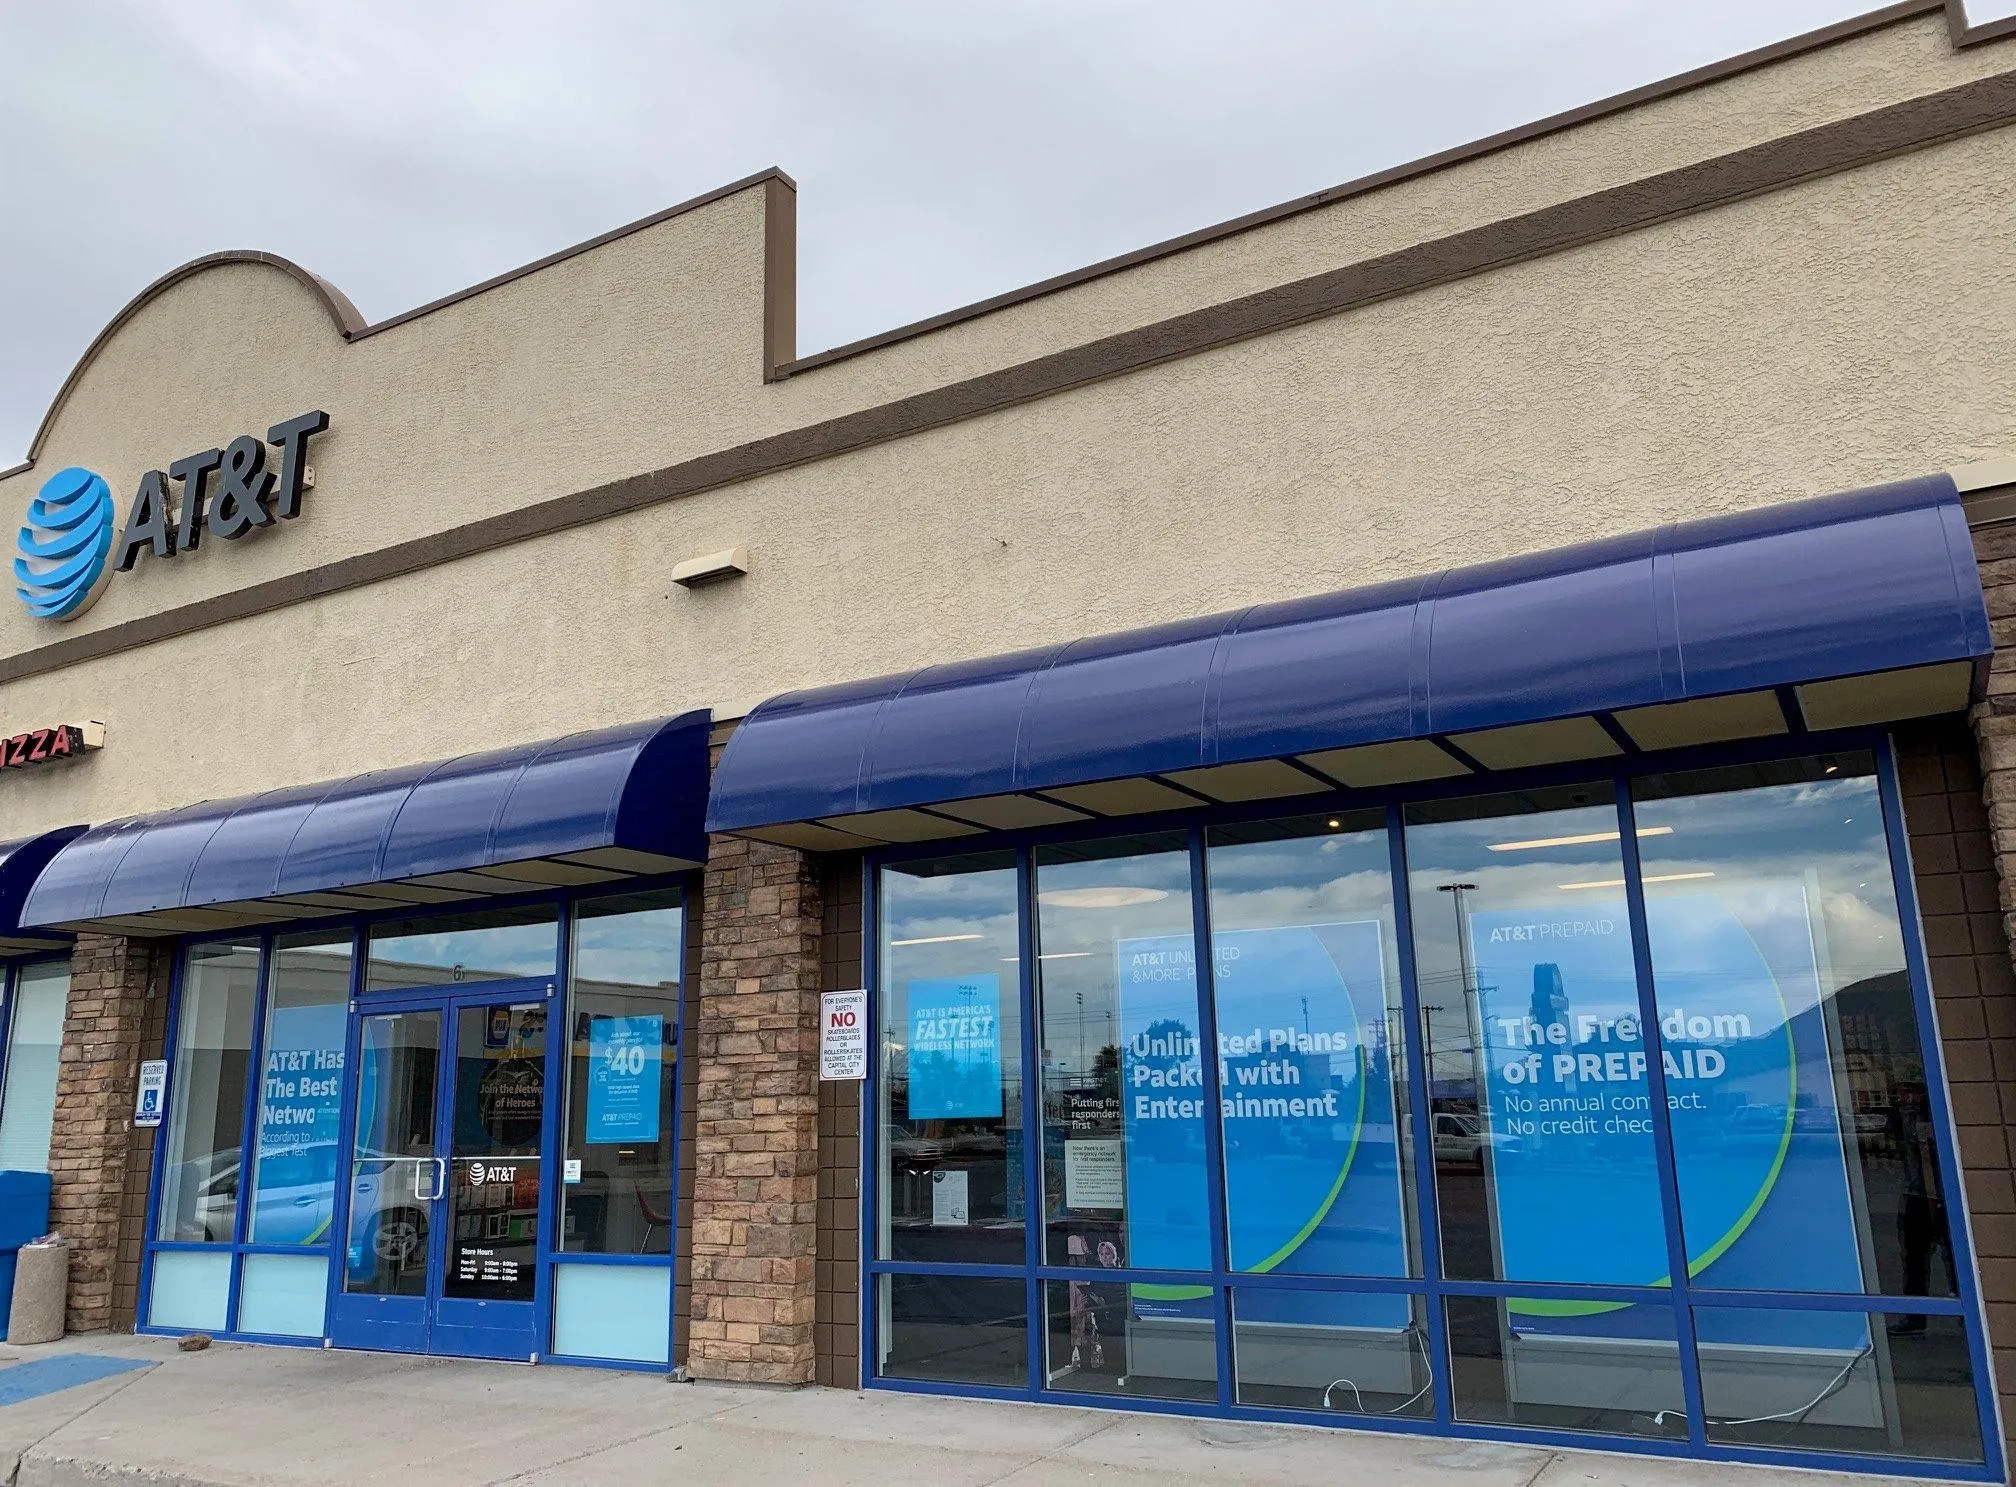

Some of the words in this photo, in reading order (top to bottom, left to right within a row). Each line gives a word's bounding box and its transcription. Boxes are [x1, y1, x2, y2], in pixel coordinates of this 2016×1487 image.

[114, 410, 328, 571] AT&T
[0, 725, 71, 768] IZZA
[1490, 925, 1535, 942] AT&T
[1539, 920, 1614, 938] PREPAID
[1132, 952, 1166, 966] AT&T
[1169, 947, 1240, 964] UNLTED
[1187, 965, 1231, 979] PNS
[831, 1012, 856, 1027] NO
[916, 1008, 936, 1019] AT&T
[938, 1008, 946, 1017] IS
[947, 1004, 992, 1017] AMERICA'S
[915, 1016, 993, 1040] FASTEST
[1497, 1016, 1567, 1046] The
[1578, 1009, 1750, 1044] Fredom
[913, 1040, 952, 1051] WIRELESS
[954, 1038, 995, 1049] NETWORK
[1133, 1028, 1262, 1057] Unlimted
[1270, 1027, 1348, 1053] Plans
[268, 1051, 310, 1072] AT&T
[314, 1049, 345, 1070] Has
[604, 1045, 645, 1076] $40
[1502, 1054, 1541, 1084] of
[1552, 1049, 1726, 1083] PREPAID
[1235, 1059, 1300, 1086] with
[266, 1077, 295, 1098] The
[300, 1076, 338, 1097] Best
[480, 1083, 498, 1094] Join
[499, 1083, 514, 1094] the
[514, 1083, 543, 1094] Netwo
[496, 1098, 505, 1108] of
[506, 1098, 536, 1108] Heroes
[1071, 1098, 1104, 1109] Putting
[1105, 1097, 1120, 1107] firs
[1135, 1092, 1338, 1119] Enterainment
[1505, 1096, 1533, 1113] No
[1539, 1093, 1605, 1111] annual
[1611, 1092, 1707, 1110] conact.
[263, 1105, 315, 1125] Netwo
[602, 1113, 617, 1122] AT&T
[618, 1111, 643, 1121] PREPAID
[1071, 1110, 1120, 1120] responders
[1508, 1118, 1535, 1135] No
[1541, 1116, 1599, 1135] credit
[1604, 1115, 1654, 1134] chec
[1072, 1121, 1091, 1130] first
[262, 1131, 299, 1146] According
[301, 1132, 310, 1142] to
[486, 1166, 516, 1182] AT&T
[477, 1248, 493, 1256] Hours
